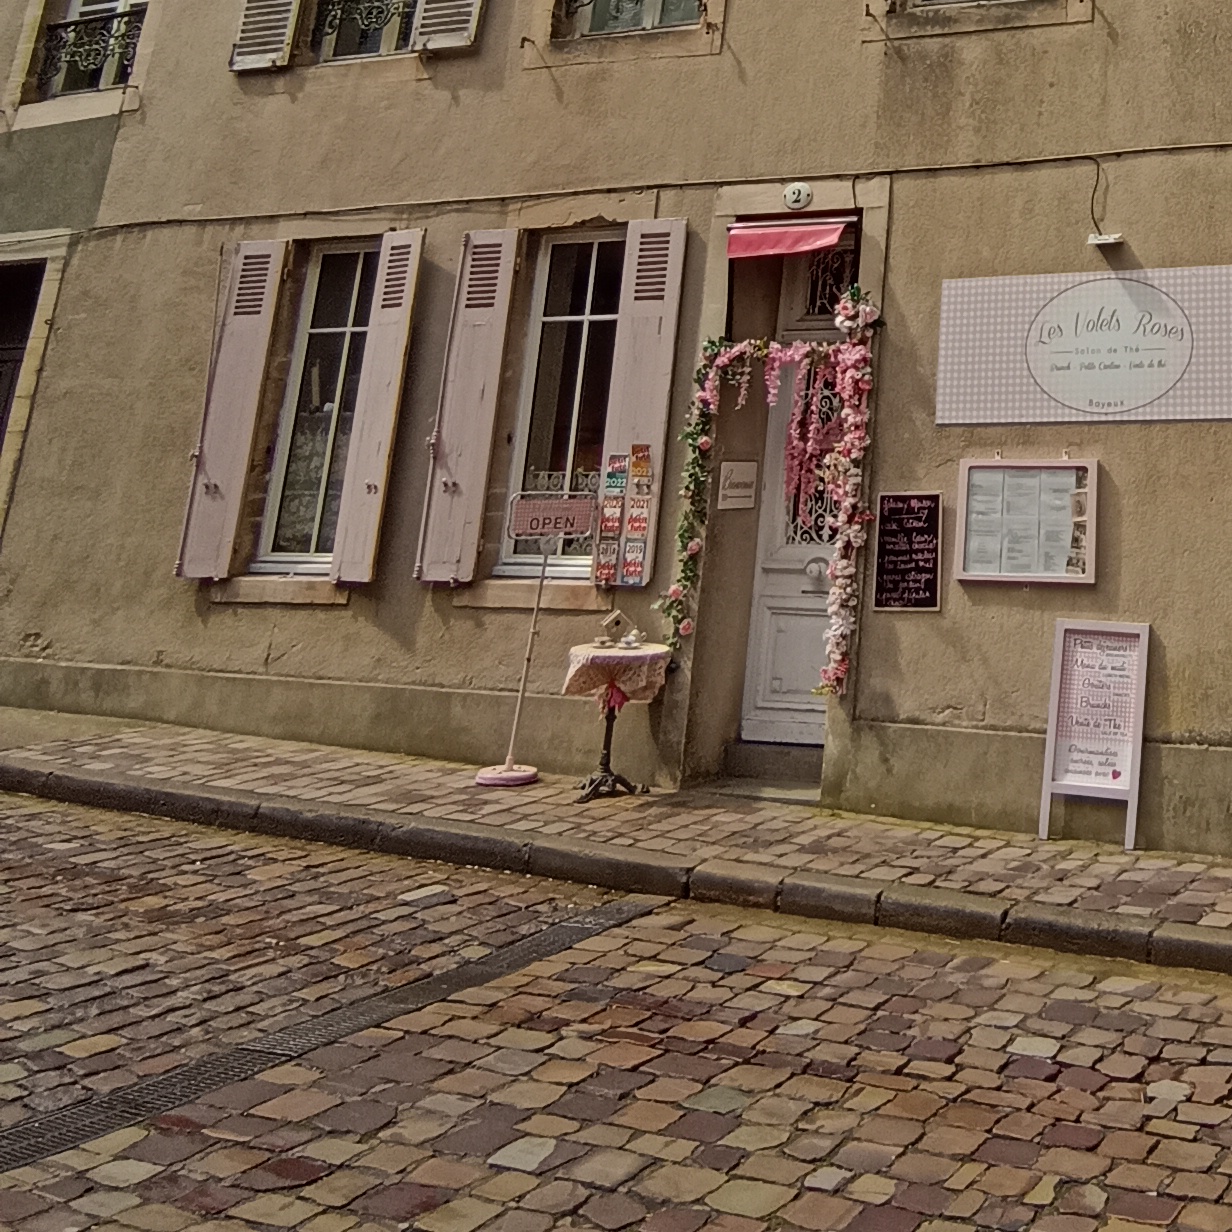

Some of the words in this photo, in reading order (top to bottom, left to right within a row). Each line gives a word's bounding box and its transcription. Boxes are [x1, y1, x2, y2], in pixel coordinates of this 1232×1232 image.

[791, 188, 801, 203] 2
[1038, 322, 1063, 345] Les
[1074, 306, 1121, 338] Volets
[1133, 310, 1185, 342] Roses
[1074, 347, 1102, 355] Salon
[1107, 345, 1118, 354] de
[1123, 344, 1140, 353] Thé
[1088, 398, 1125, 409] Bayeux
[605, 477, 627, 487] 2022
[630, 499, 649, 509] 2021
[529, 516, 575, 531] OPEN
[627, 544, 643, 554] 2019
